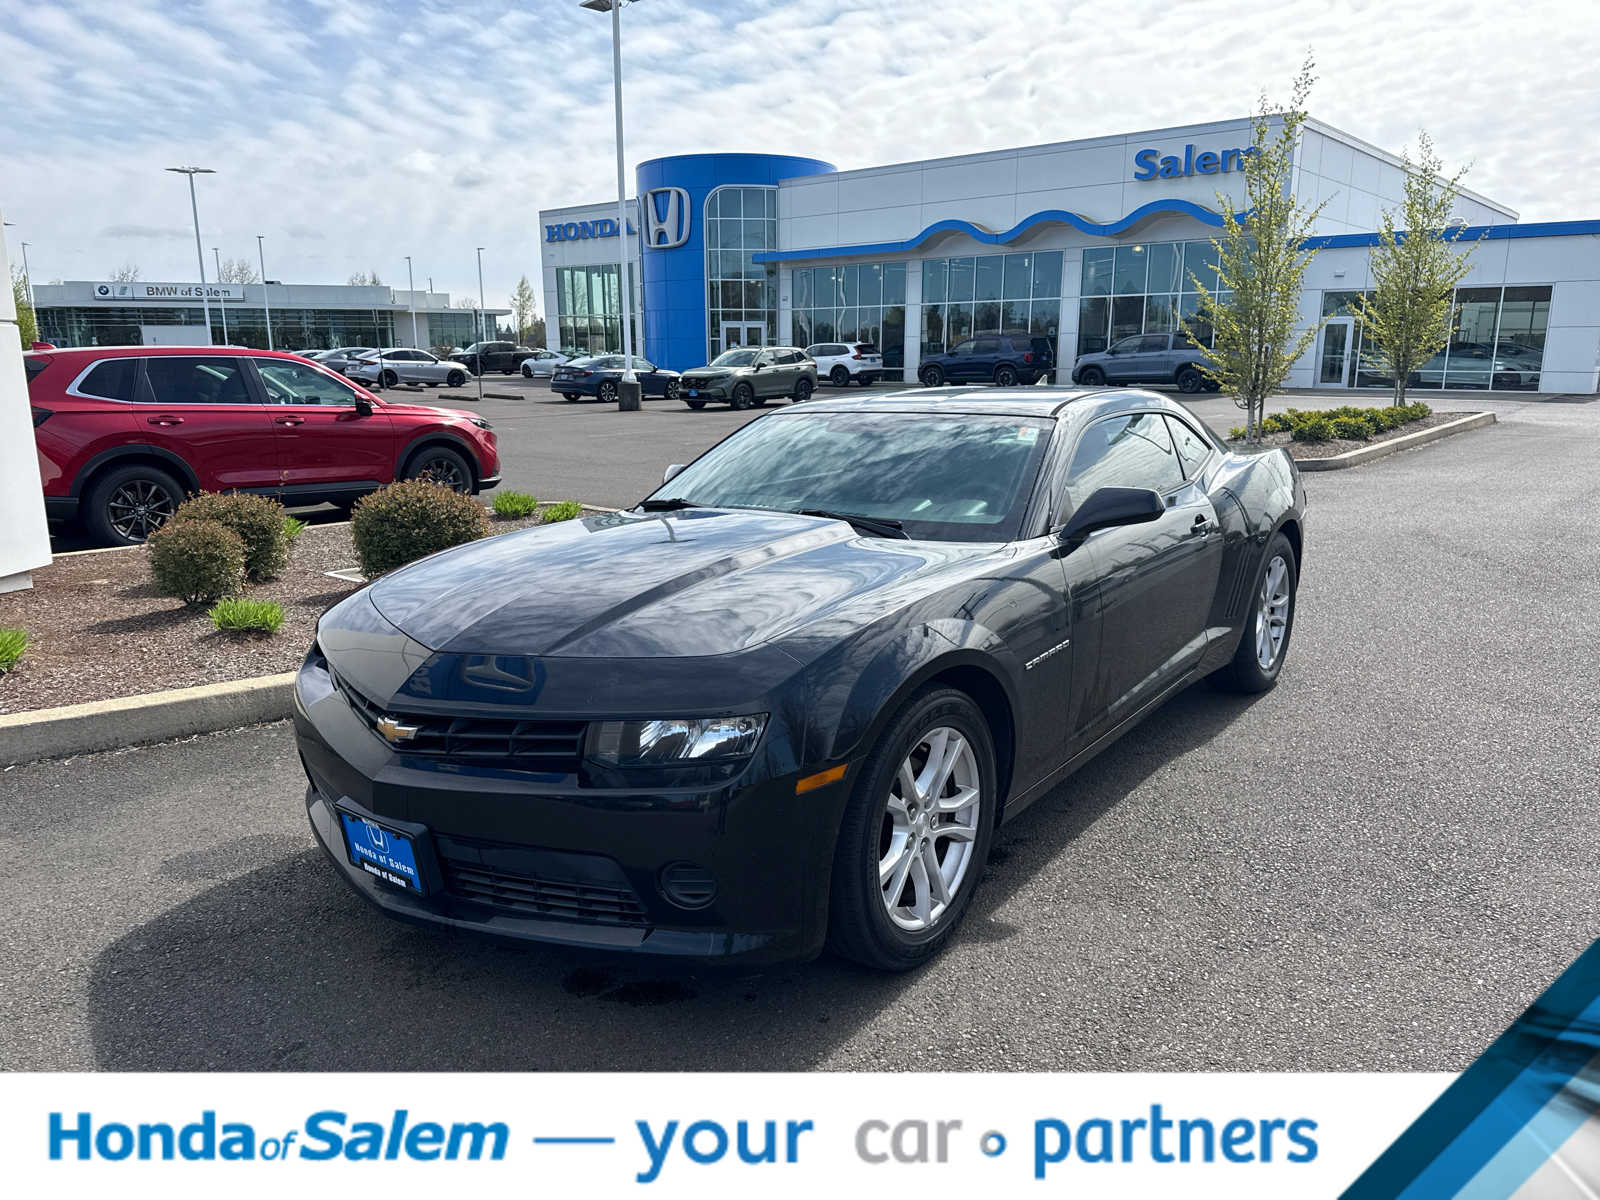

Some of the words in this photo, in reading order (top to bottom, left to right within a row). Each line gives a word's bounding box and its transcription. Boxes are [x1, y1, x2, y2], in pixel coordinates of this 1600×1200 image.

[1134, 144, 1261, 181] Salem
[545, 216, 637, 242] HONDA
[146, 286, 177, 296] BMW
[181, 287, 192, 297] of
[354, 841, 377, 860] Honda
[379, 854, 387, 864] of
[388, 857, 415, 876] Salem
[363, 862, 381, 877] Honda
